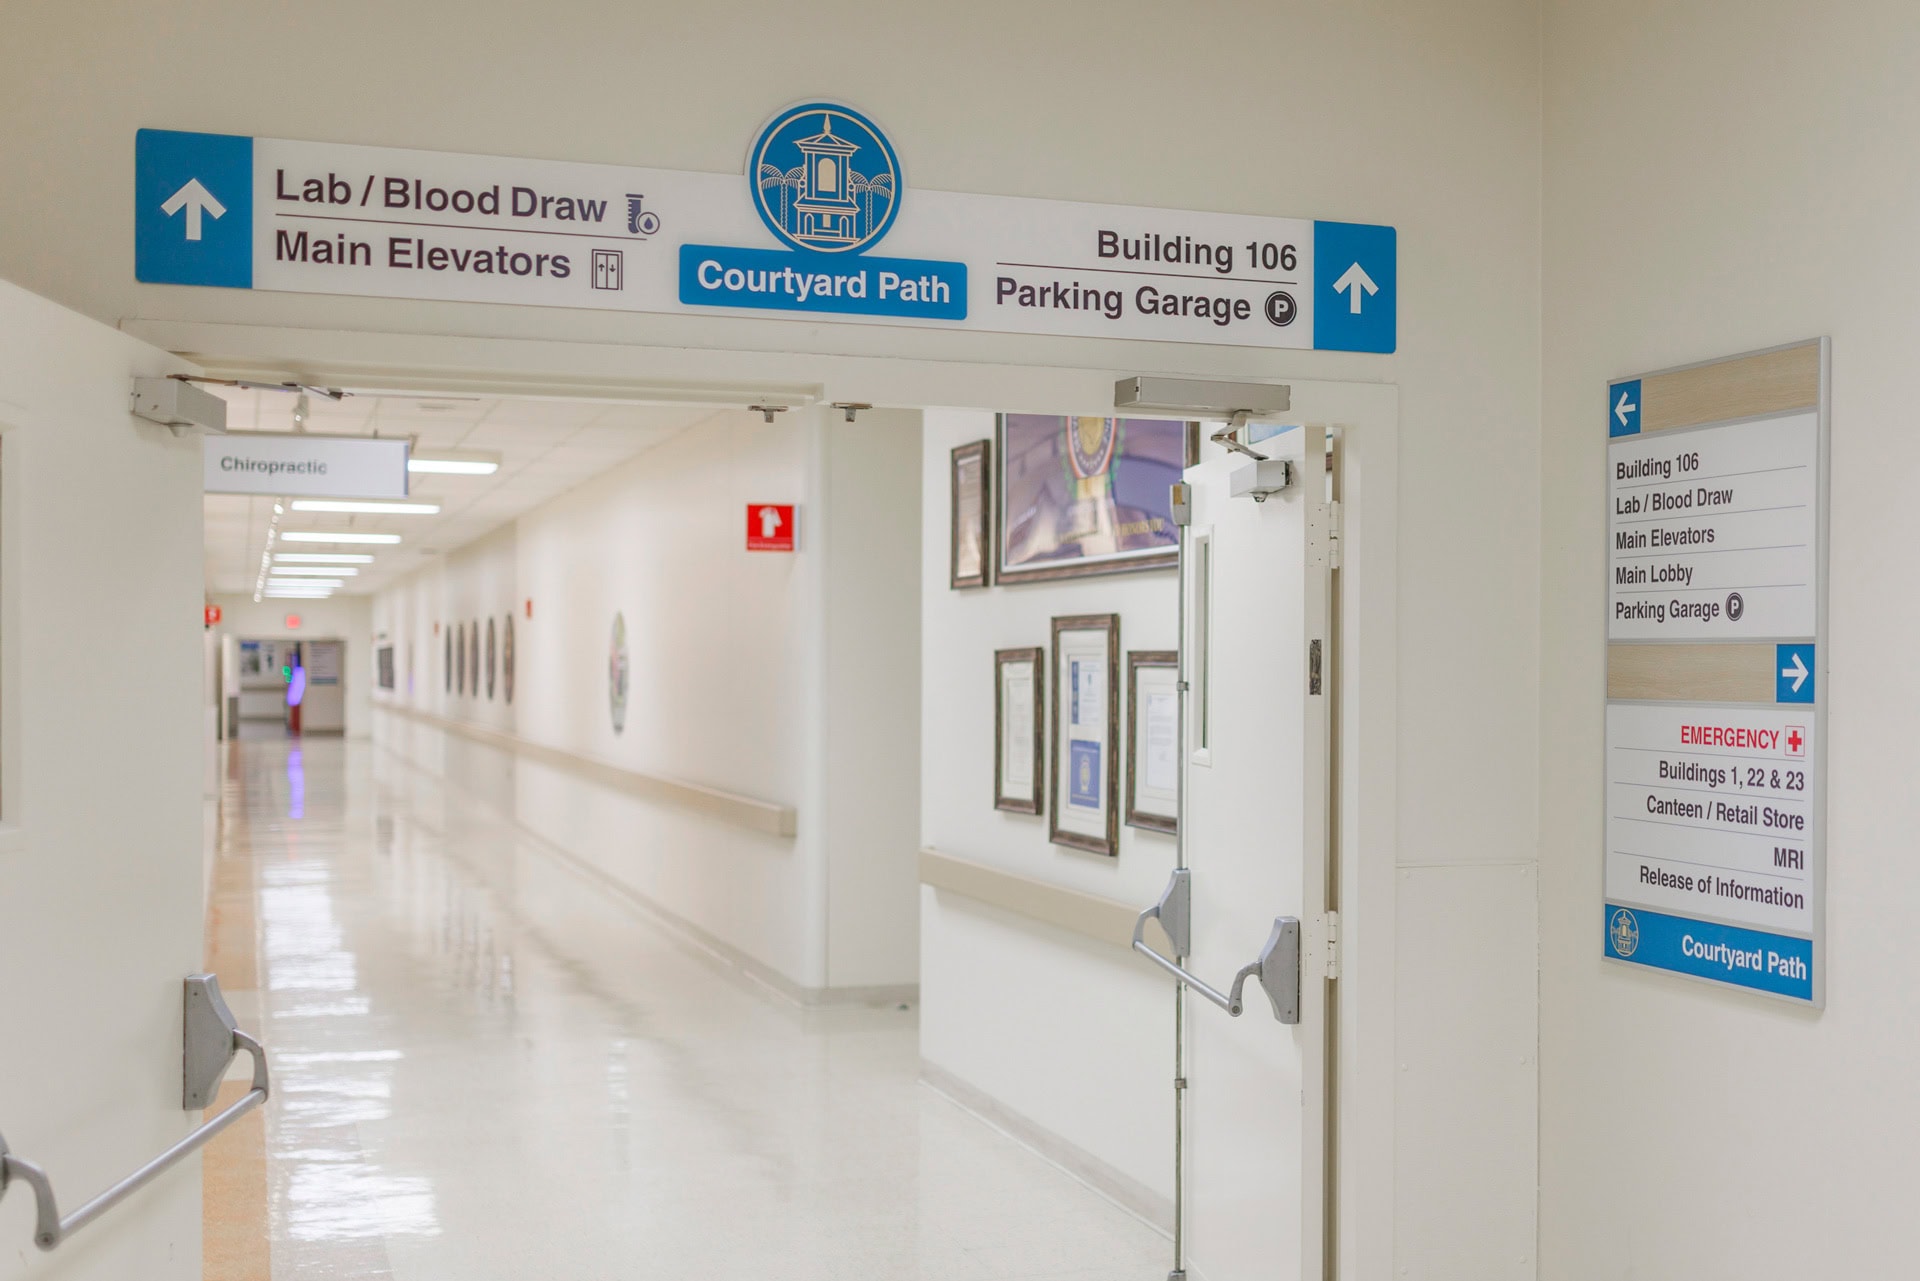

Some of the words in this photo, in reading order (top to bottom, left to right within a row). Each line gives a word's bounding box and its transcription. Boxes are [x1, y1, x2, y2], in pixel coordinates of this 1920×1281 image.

[277, 169, 351, 204] Lab
[385, 177, 499, 215] Blood
[512, 187, 607, 222] Draw
[277, 230, 370, 265] Main
[389, 236, 571, 278] Elevators
[1098, 231, 1232, 273] Building
[1246, 242, 1296, 271] 106
[698, 260, 866, 302] Courtyard
[880, 272, 949, 303] Path
[997, 277, 1122, 319] Parking
[1136, 286, 1250, 326] Garage
[221, 456, 325, 475] Chiropractic
[1617, 458, 1671, 480] Building
[1676, 453, 1698, 472] 106
[1617, 496, 1640, 514] Lab
[1653, 490, 1692, 511] Blood
[1698, 488, 1733, 506] Draw
[1617, 531, 1646, 549] Main
[1652, 527, 1714, 547] Elevators
[1616, 566, 1646, 584] Main
[1651, 564, 1692, 586] Lobby
[1616, 601, 1664, 623] Parking
[1670, 600, 1719, 622] Garage
[1681, 726, 1779, 749] EMERGENCY
[1660, 761, 1725, 787] Buildings
[1731, 767, 1742, 789] 1,
[1747, 768, 1764, 787] 22
[1770, 770, 1780, 788] &
[1786, 771, 1804, 791] 23
[1647, 795, 1702, 818] Canteen
[1717, 803, 1757, 824] Retail
[1763, 807, 1804, 830] Store
[1775, 847, 1803, 870] MRI
[1641, 865, 1693, 890] Release
[1698, 876, 1711, 893] of
[1717, 877, 1803, 909] Information
[1682, 935, 1762, 970] Courtyard
[1768, 952, 1806, 980] Path
